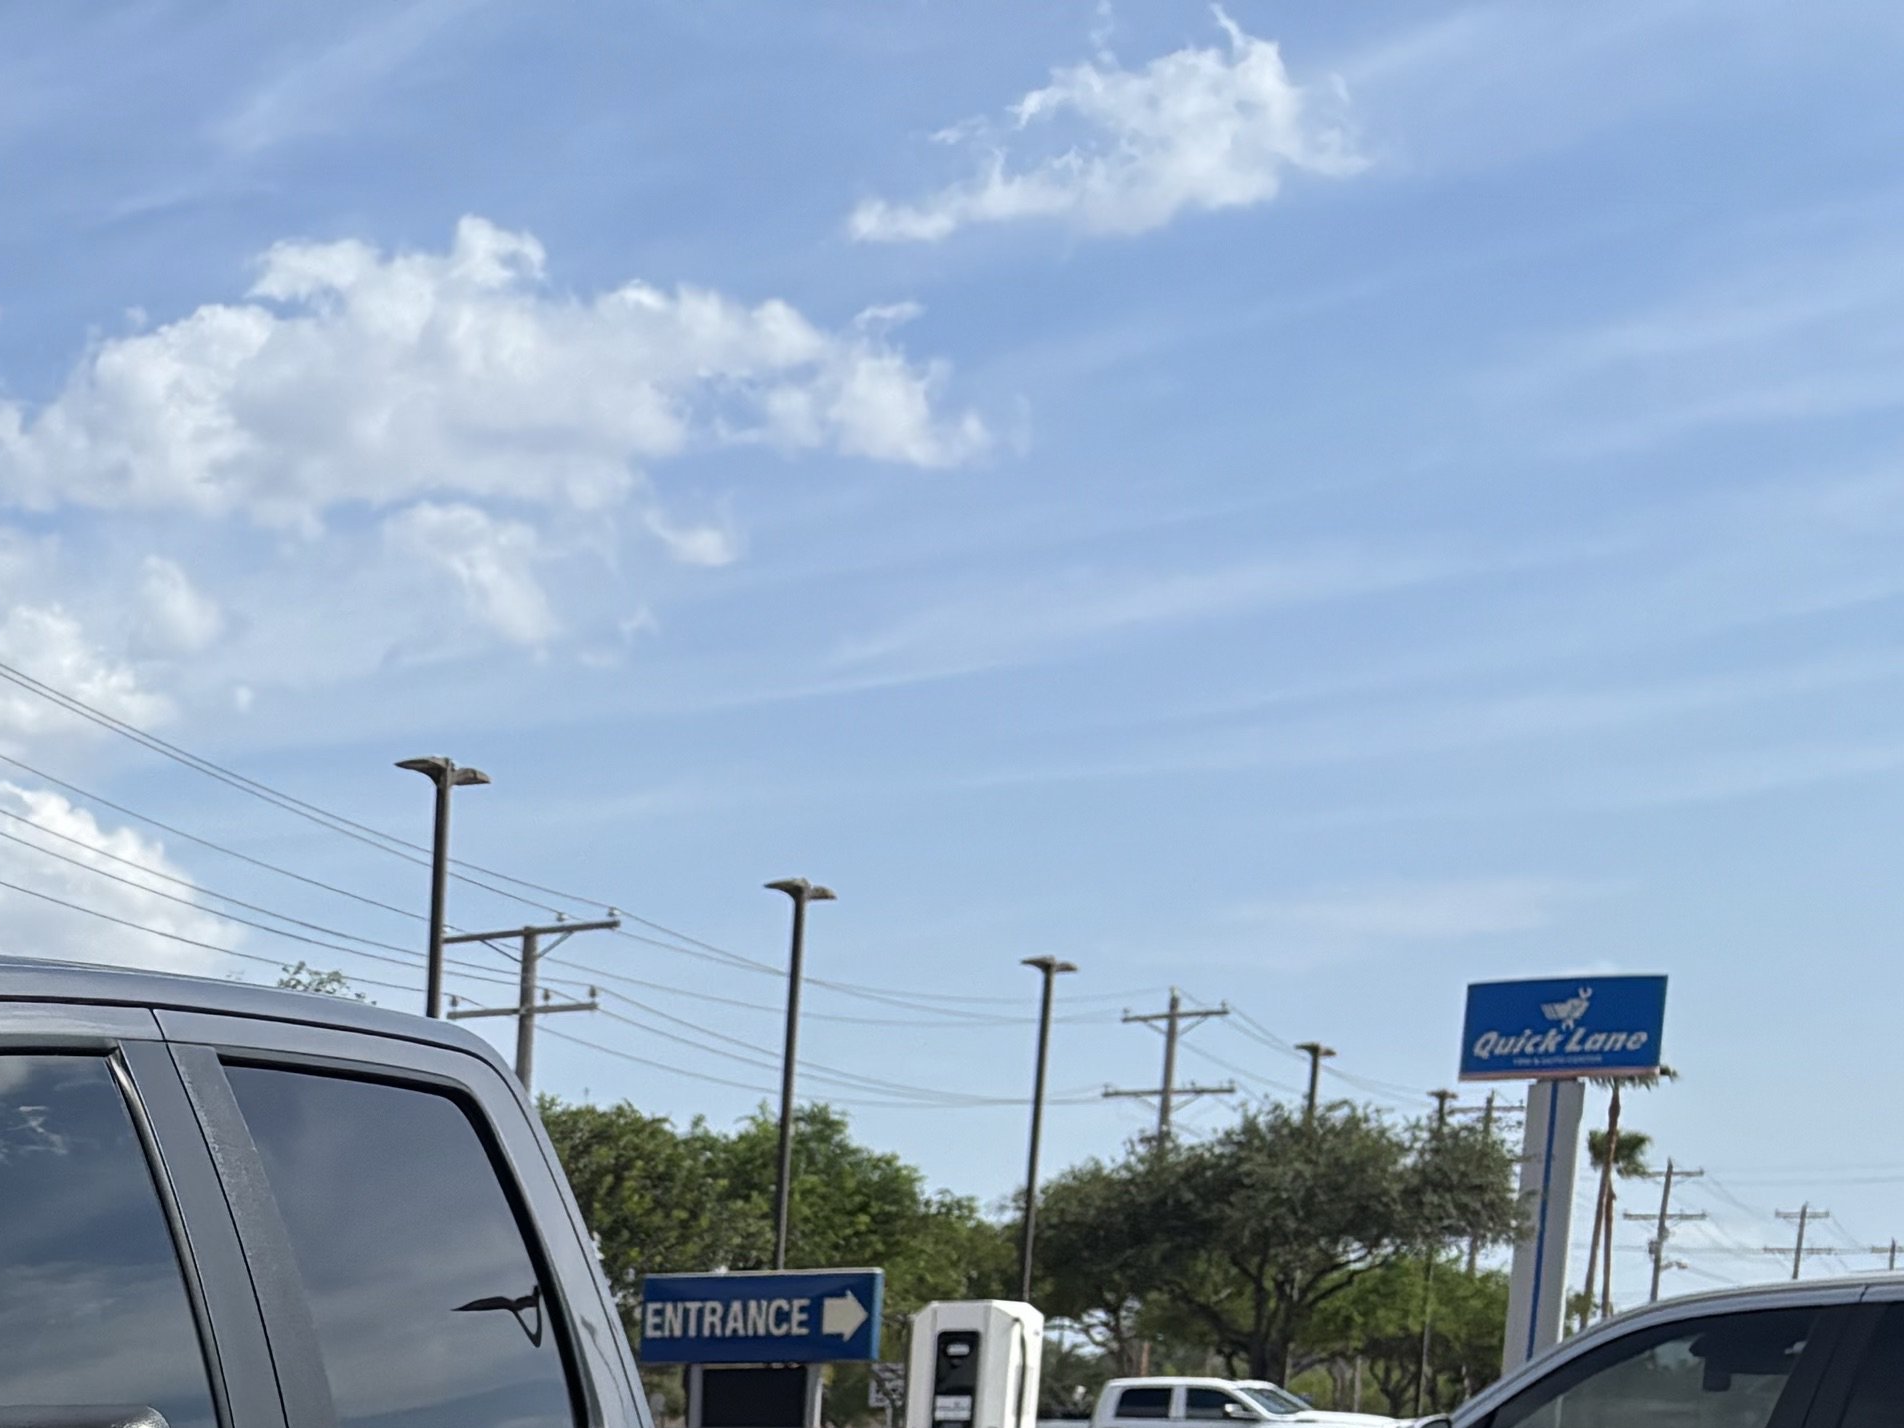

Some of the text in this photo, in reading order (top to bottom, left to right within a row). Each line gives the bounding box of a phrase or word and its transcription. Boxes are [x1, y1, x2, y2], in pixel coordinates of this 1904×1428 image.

[1473, 1026, 1648, 1059] Quick Lane
[645, 1298, 811, 1339] ENTRANCE
